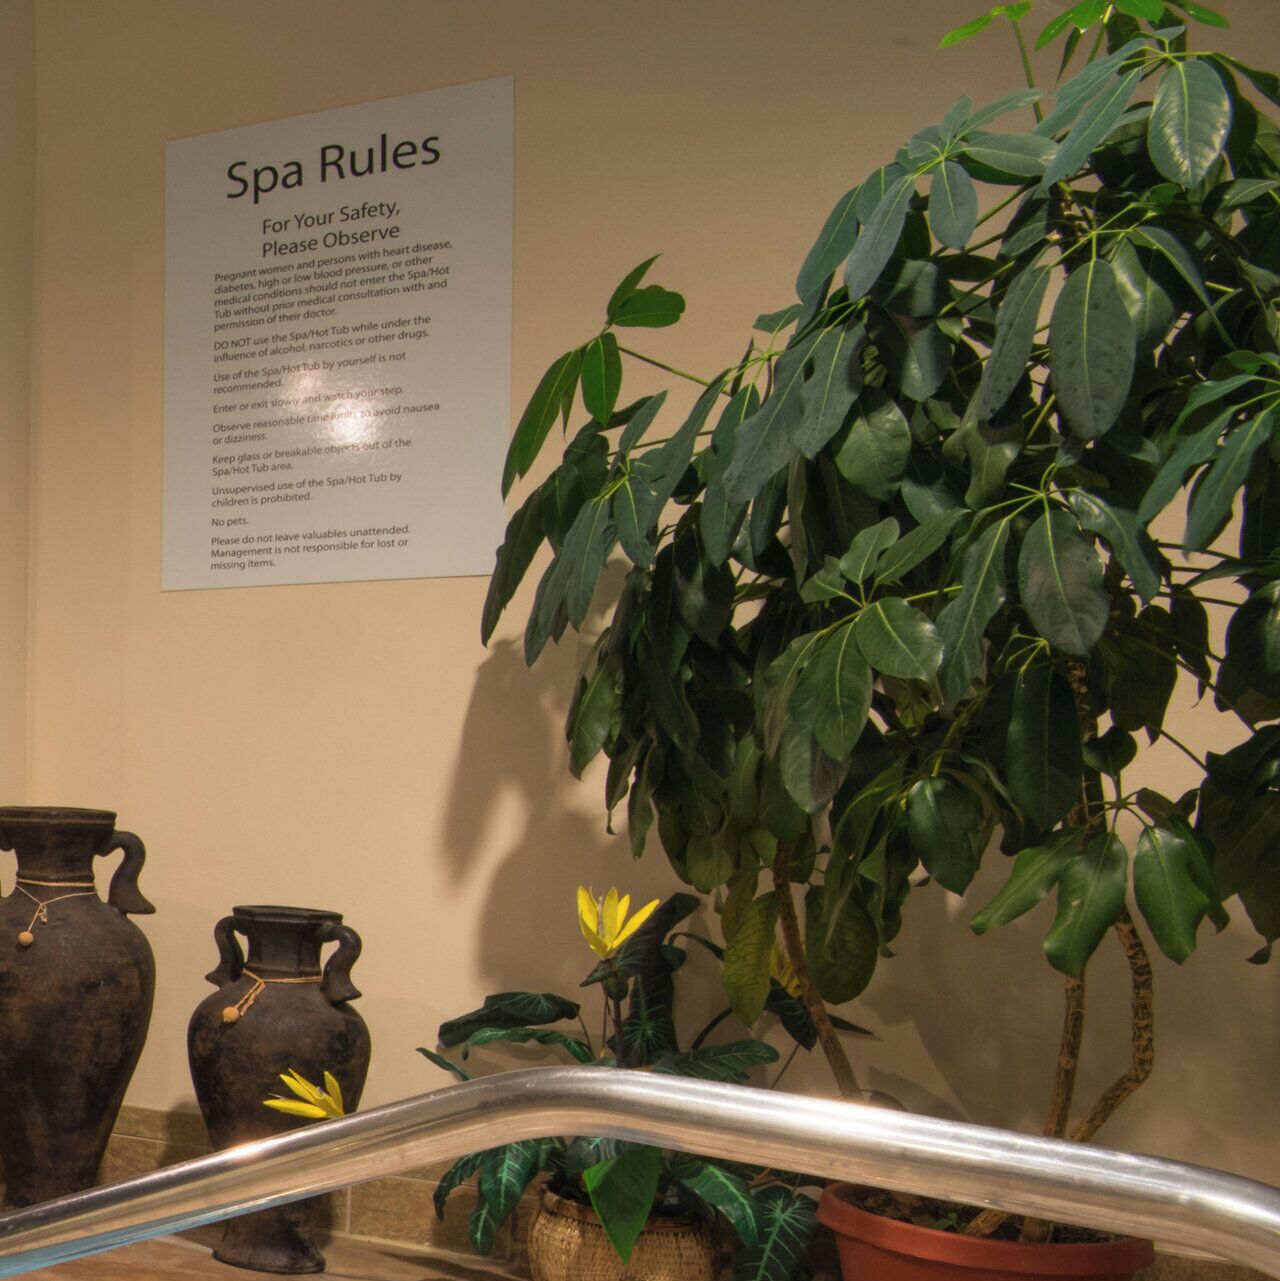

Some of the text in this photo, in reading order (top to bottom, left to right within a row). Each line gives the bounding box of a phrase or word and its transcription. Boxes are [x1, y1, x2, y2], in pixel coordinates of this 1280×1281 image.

[226, 134, 440, 204] Spa Rules
[262, 201, 400, 234] For Your Safety,
[262, 226, 400, 258] Please Observe
[214, 256, 433, 295] diabetes, high or low blood pressure, or other
[215, 242, 452, 282] Pregnant women and persons with heart disease,
[214, 267, 450, 307] medical conditions should not enter the Spa/Hot
[214, 278, 448, 319] Tub without prior medical consultation with and
[214, 308, 337, 333] permission of their doctor.
[214, 315, 431, 351] DO NOT use the Spa/Hot Tub while under the
[214, 330, 430, 362] influence of alcohol, narcotics or other drugs.
[213, 352, 407, 382] Use of the Spa/Hot Tub by yourself is not
[213, 379, 284, 394] recommended.
[213, 404, 237, 414] Enter
[251, 400, 268, 410] exit
[270, 397, 300, 408] slowly
[302, 394, 321, 403] and
[324, 391, 353, 401] watch
[354, 390, 379, 399] your
[380, 386, 403, 396] step.
[212, 423, 252, 433] Observe
[253, 416, 306, 428] reasonable
[307, 414, 328, 423] time
[373, 406, 401, 416] avoid
[403, 404, 440, 414] nausea
[212, 438, 412, 465] Keep glass or breakable objects out of the
[224, 433, 268, 444] dizziness.
[212, 463, 294, 478] Spa/Hot Tub area.
[212, 472, 403, 496] Unsupervised use of the Spa/Hot Tub by
[211, 492, 312, 508] children is prohibited.
[211, 525, 411, 546] Please do not leave valuables unattended.
[212, 518, 249, 528] No pets.
[211, 547, 273, 558] Management
[274, 545, 282, 554] is
[284, 545, 300, 553] not
[303, 541, 359, 553] responsible
[361, 539, 375, 549] for
[377, 539, 396, 548] lost
[211, 561, 246, 571] missing
